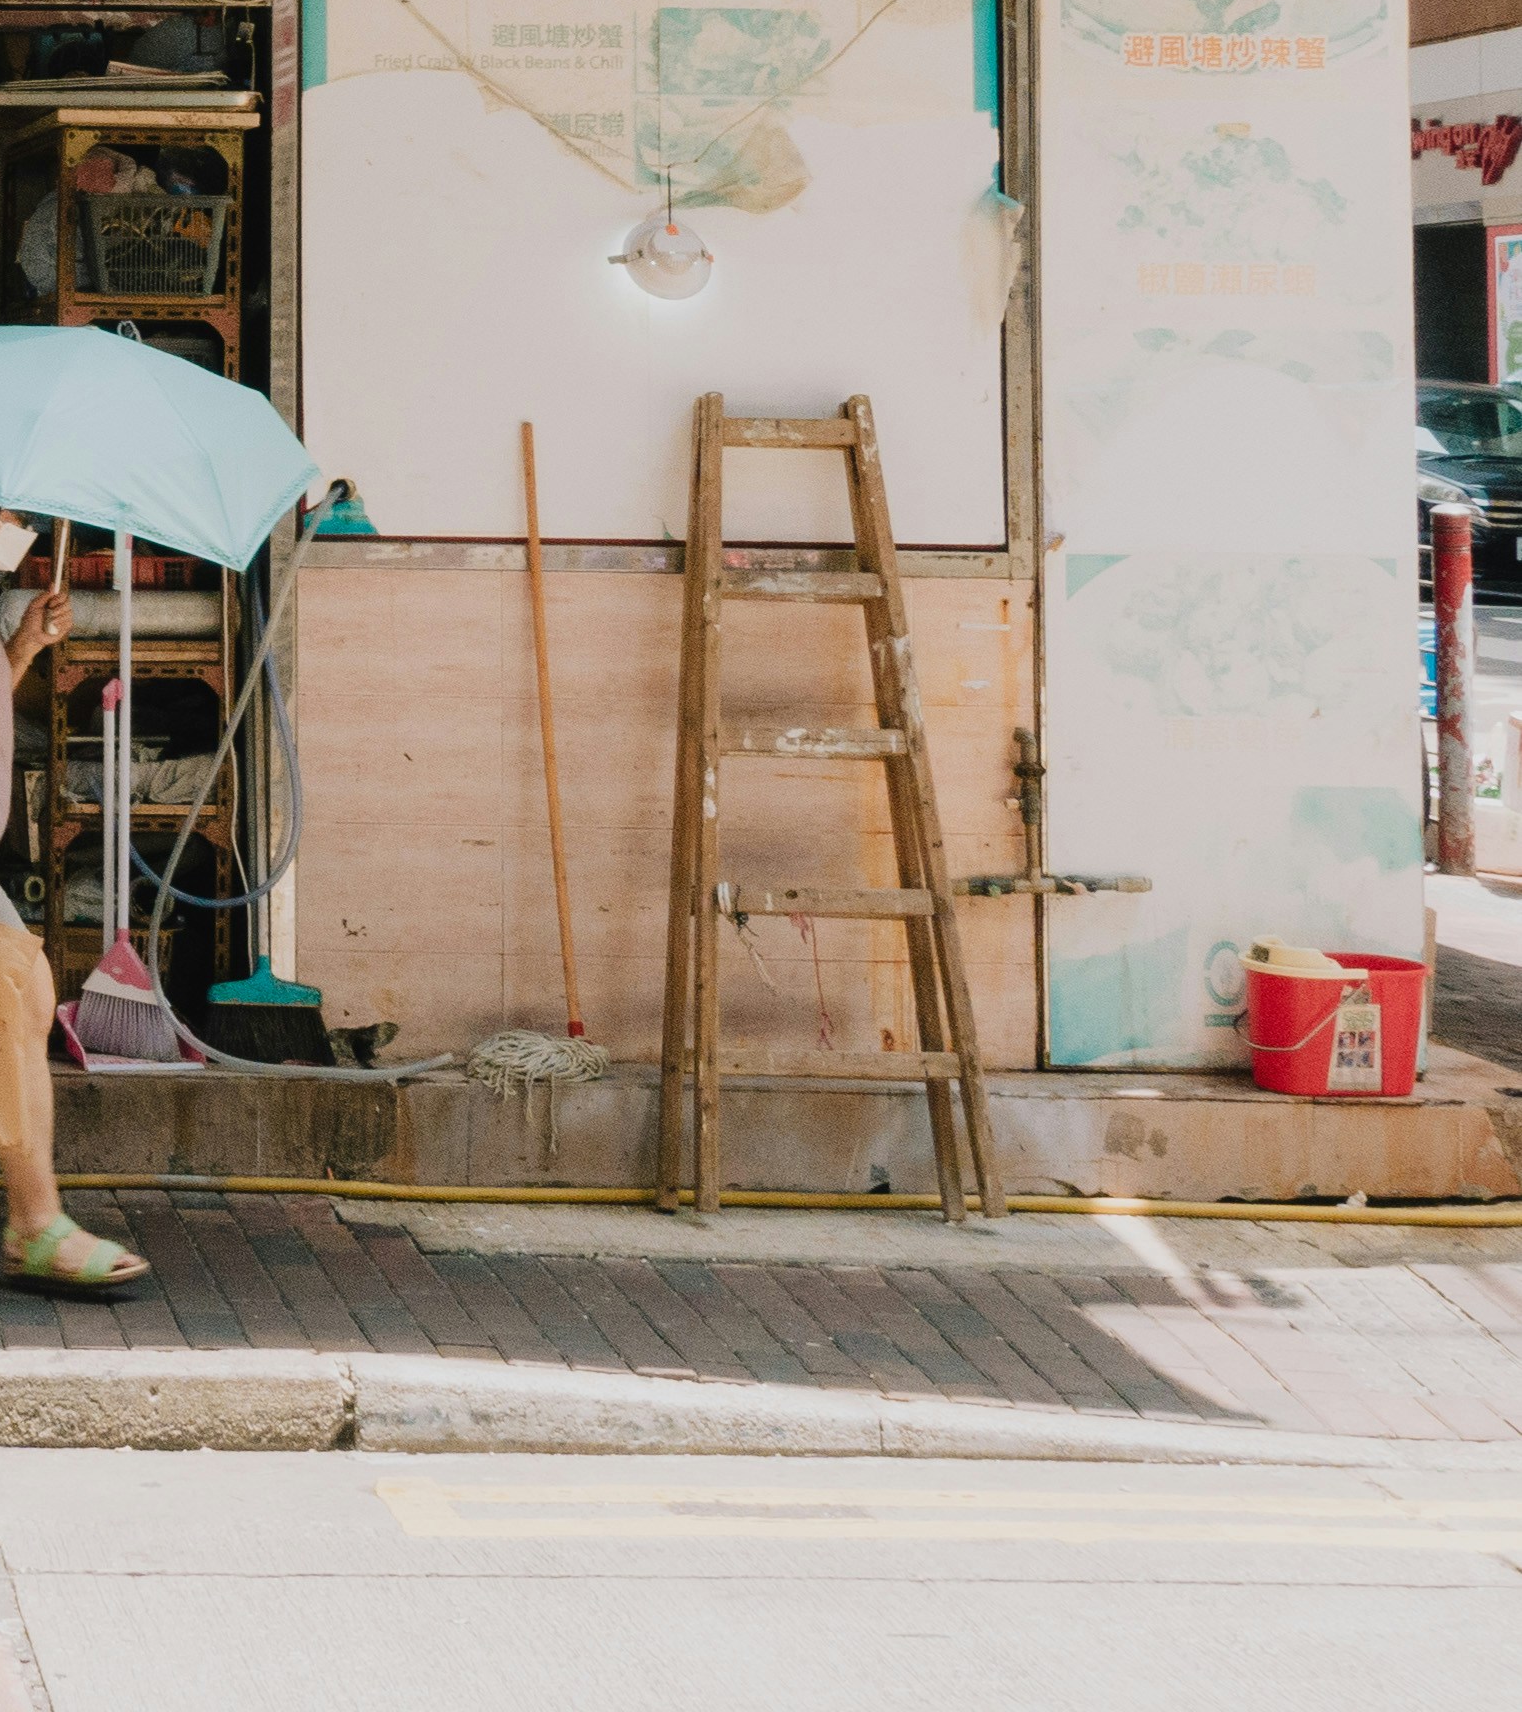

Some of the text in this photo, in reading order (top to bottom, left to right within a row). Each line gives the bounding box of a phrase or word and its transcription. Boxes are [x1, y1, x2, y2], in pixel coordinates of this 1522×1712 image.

[491, 23, 625, 49] 避風塘炒蟹
[374, 53, 413, 70] Fried
[416, 53, 454, 70] Crab
[480, 53, 521, 70] Black
[524, 53, 565, 70] Beans
[574, 54, 585, 70] &
[589, 53, 624, 71] Chili
[1123, 35, 1327, 70] 避風塘炒辣蟹
